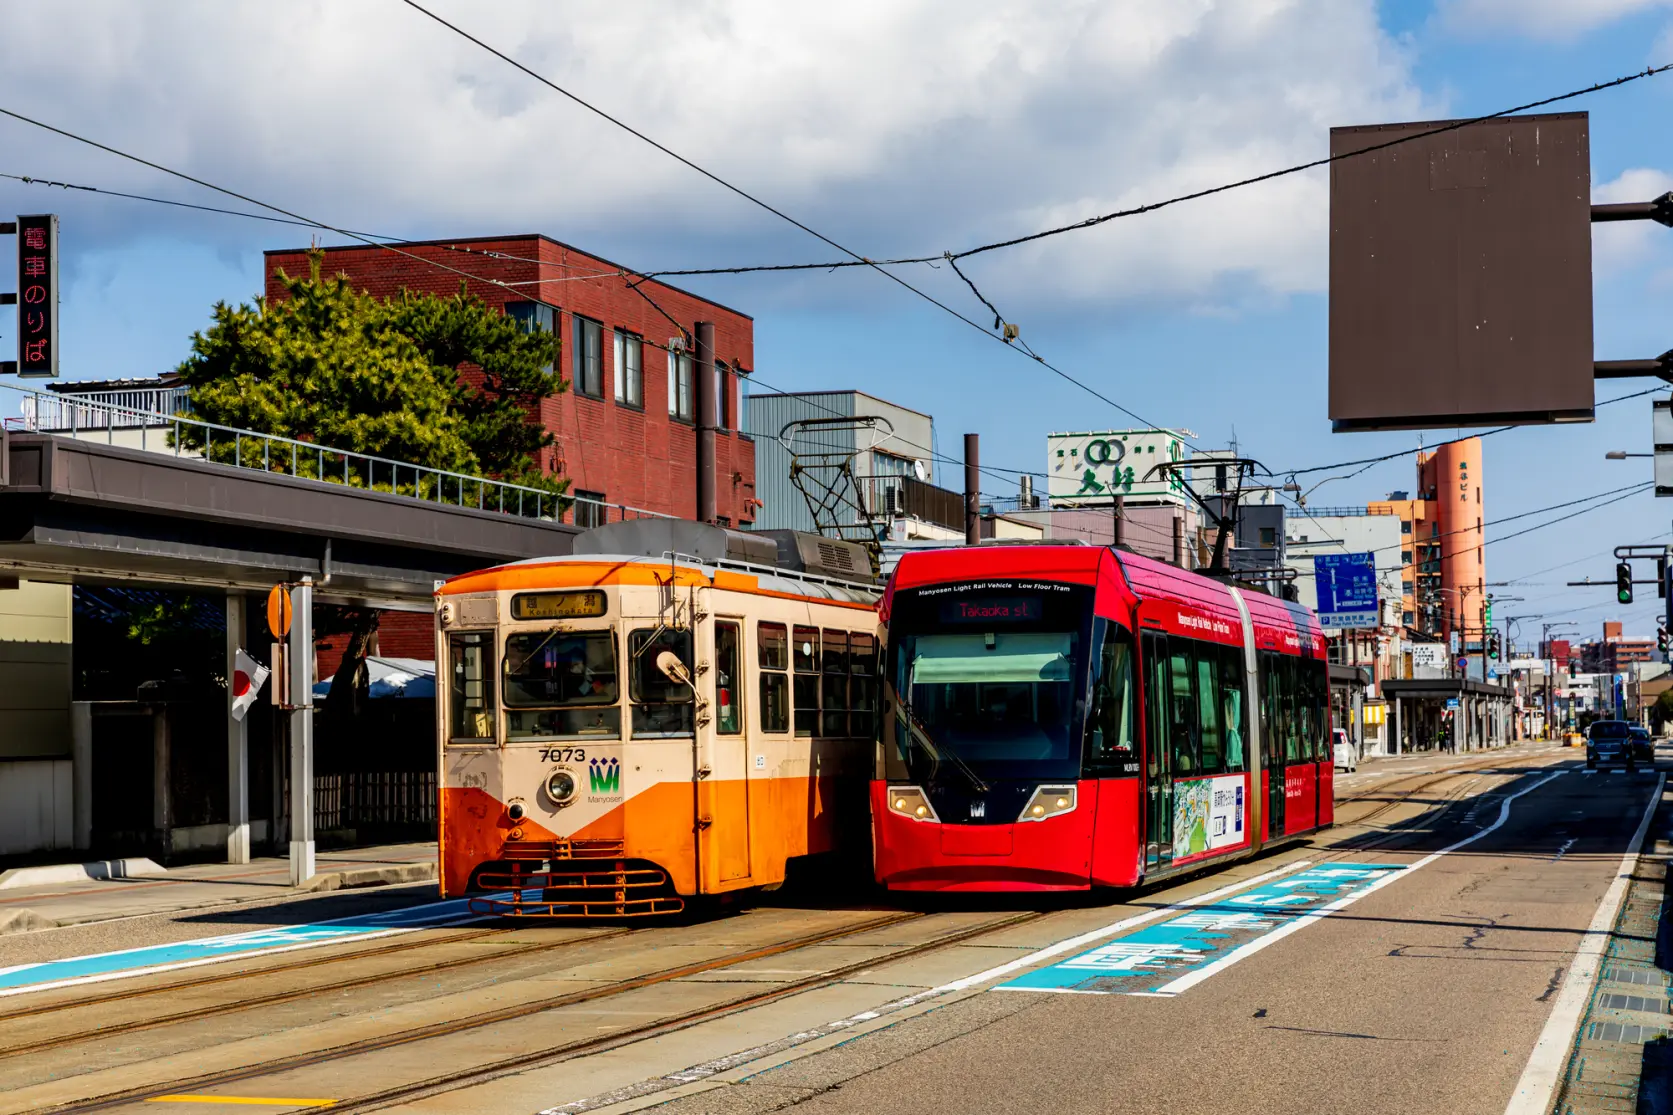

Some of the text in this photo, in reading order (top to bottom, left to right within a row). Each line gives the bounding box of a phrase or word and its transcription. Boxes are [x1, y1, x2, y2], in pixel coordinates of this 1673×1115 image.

[24, 227, 47, 362] 電車のりば
[918, 587, 952, 596] Manyosen
[959, 602, 1009, 617] Takaoka
[539, 749, 585, 763] 7073
[588, 796, 623, 804] Manyosen
